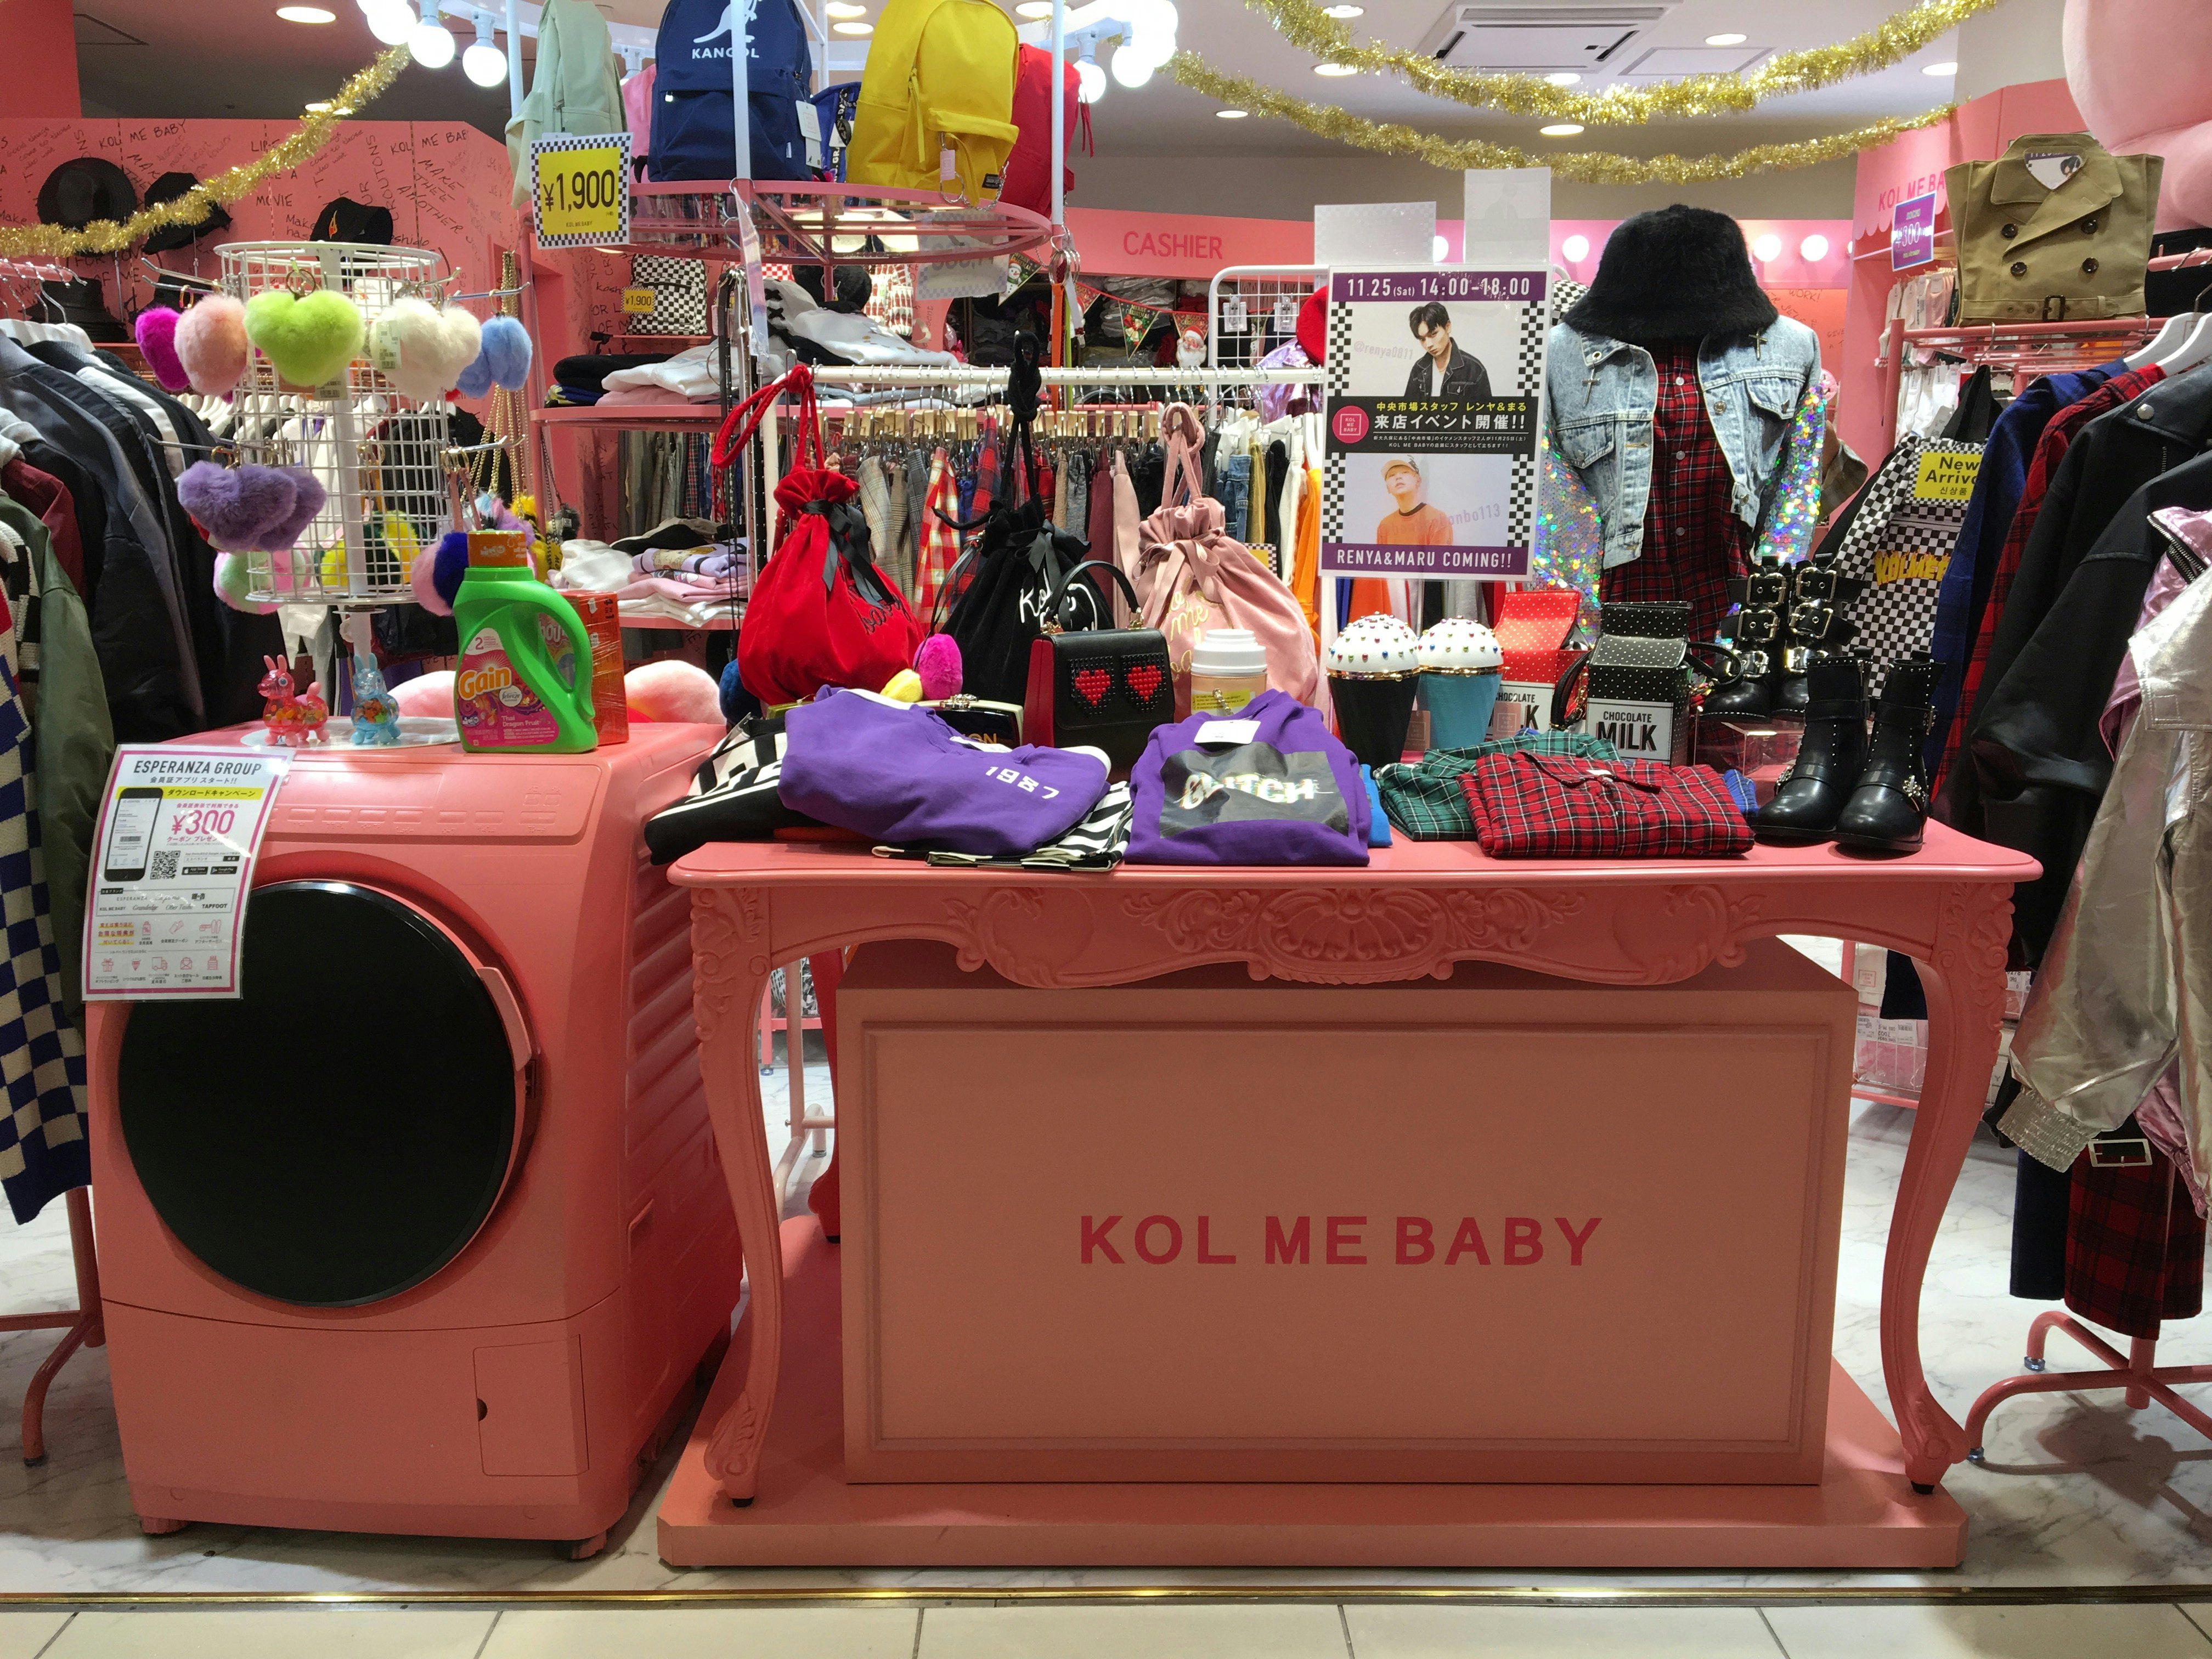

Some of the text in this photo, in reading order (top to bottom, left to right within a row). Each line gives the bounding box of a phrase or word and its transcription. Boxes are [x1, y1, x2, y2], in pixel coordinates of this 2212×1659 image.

[129, 128, 147, 143] ME
[153, 119, 187, 138] BABY
[391, 142, 411, 155] KOL
[421, 133, 439, 148] ME
[126, 154, 162, 179] MAK
[417, 159, 464, 191] MAKE
[543, 170, 615, 213] ¥1,900
[1907, 177, 1925, 199] ME
[1928, 171, 1945, 192] BA
[256, 193, 292, 207] MOVIE
[1124, 231, 1223, 259] CASHIER
[625, 296, 652, 306] ¥1,900
[1789, 289, 1821, 302] WORK!
[1353, 340, 1414, 360] @renya0811
[1376, 402, 1527, 411] 中央市場スタッフ レンヤ&まる
[1374, 414, 1525, 430] 来店イベント開催!!
[1939, 456, 1980, 471] New
[1940, 487, 1967, 496] 신상품
[1337, 549, 1511, 568] RENYA&MARU COMING!!
[475, 637, 484, 650] 2
[459, 667, 511, 699] Gain
[1603, 711, 1652, 723] CHOCOLATE
[1596, 721, 1657, 751] MILK
[133, 760, 262, 775] ESPERANZA GROUP
[986, 766, 1059, 799] 1987
[171, 810, 235, 835] ¥300
[1081, 1215, 1602, 1266] KOL ME BABY
